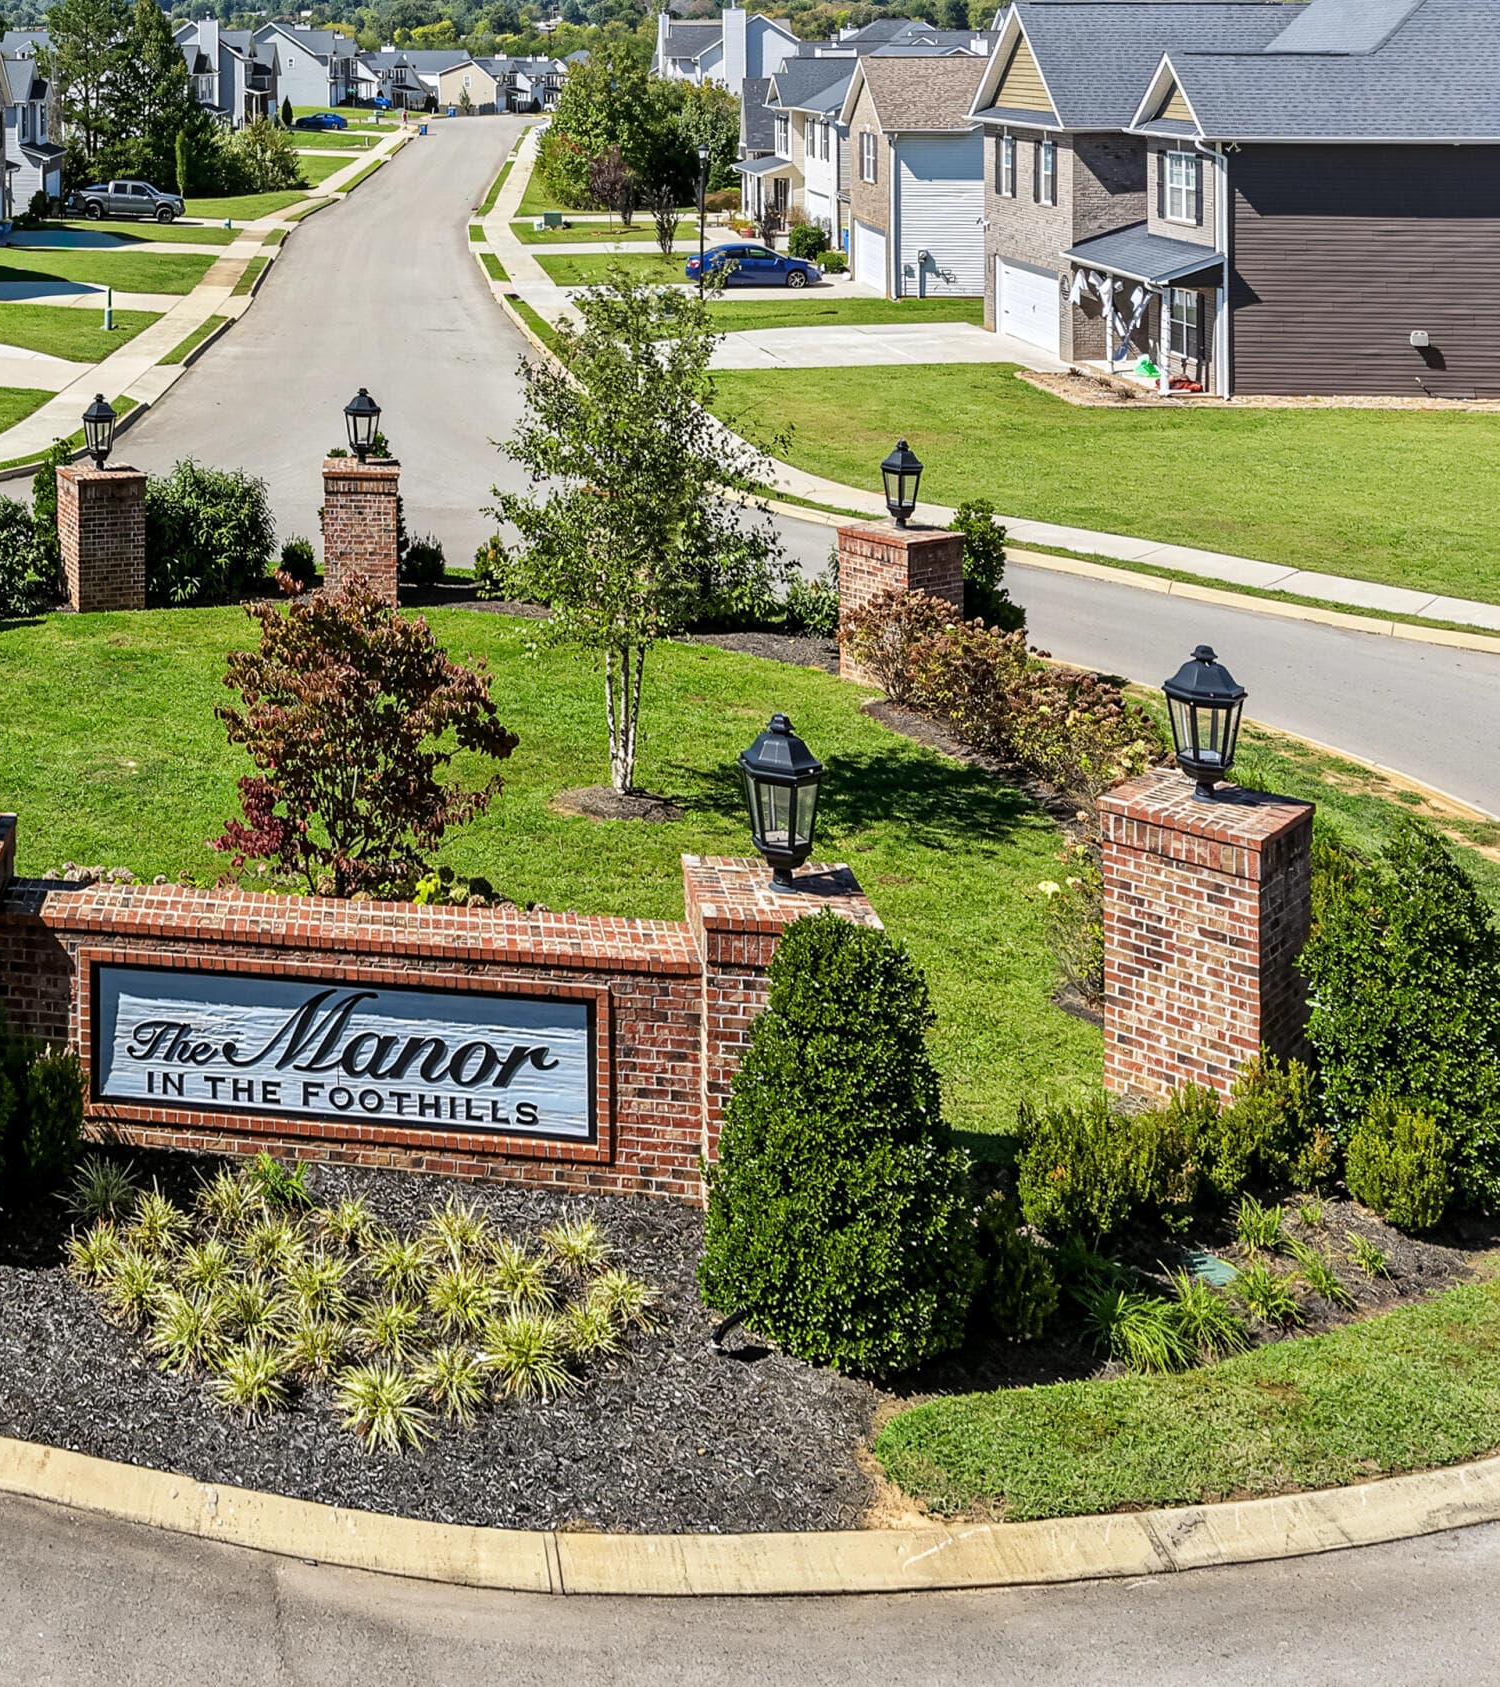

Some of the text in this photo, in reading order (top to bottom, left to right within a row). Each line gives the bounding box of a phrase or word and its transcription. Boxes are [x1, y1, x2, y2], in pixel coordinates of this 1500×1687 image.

[126, 989, 559, 1088] The Manor
[147, 1071, 539, 1126] IN THE FOOTHILLS
